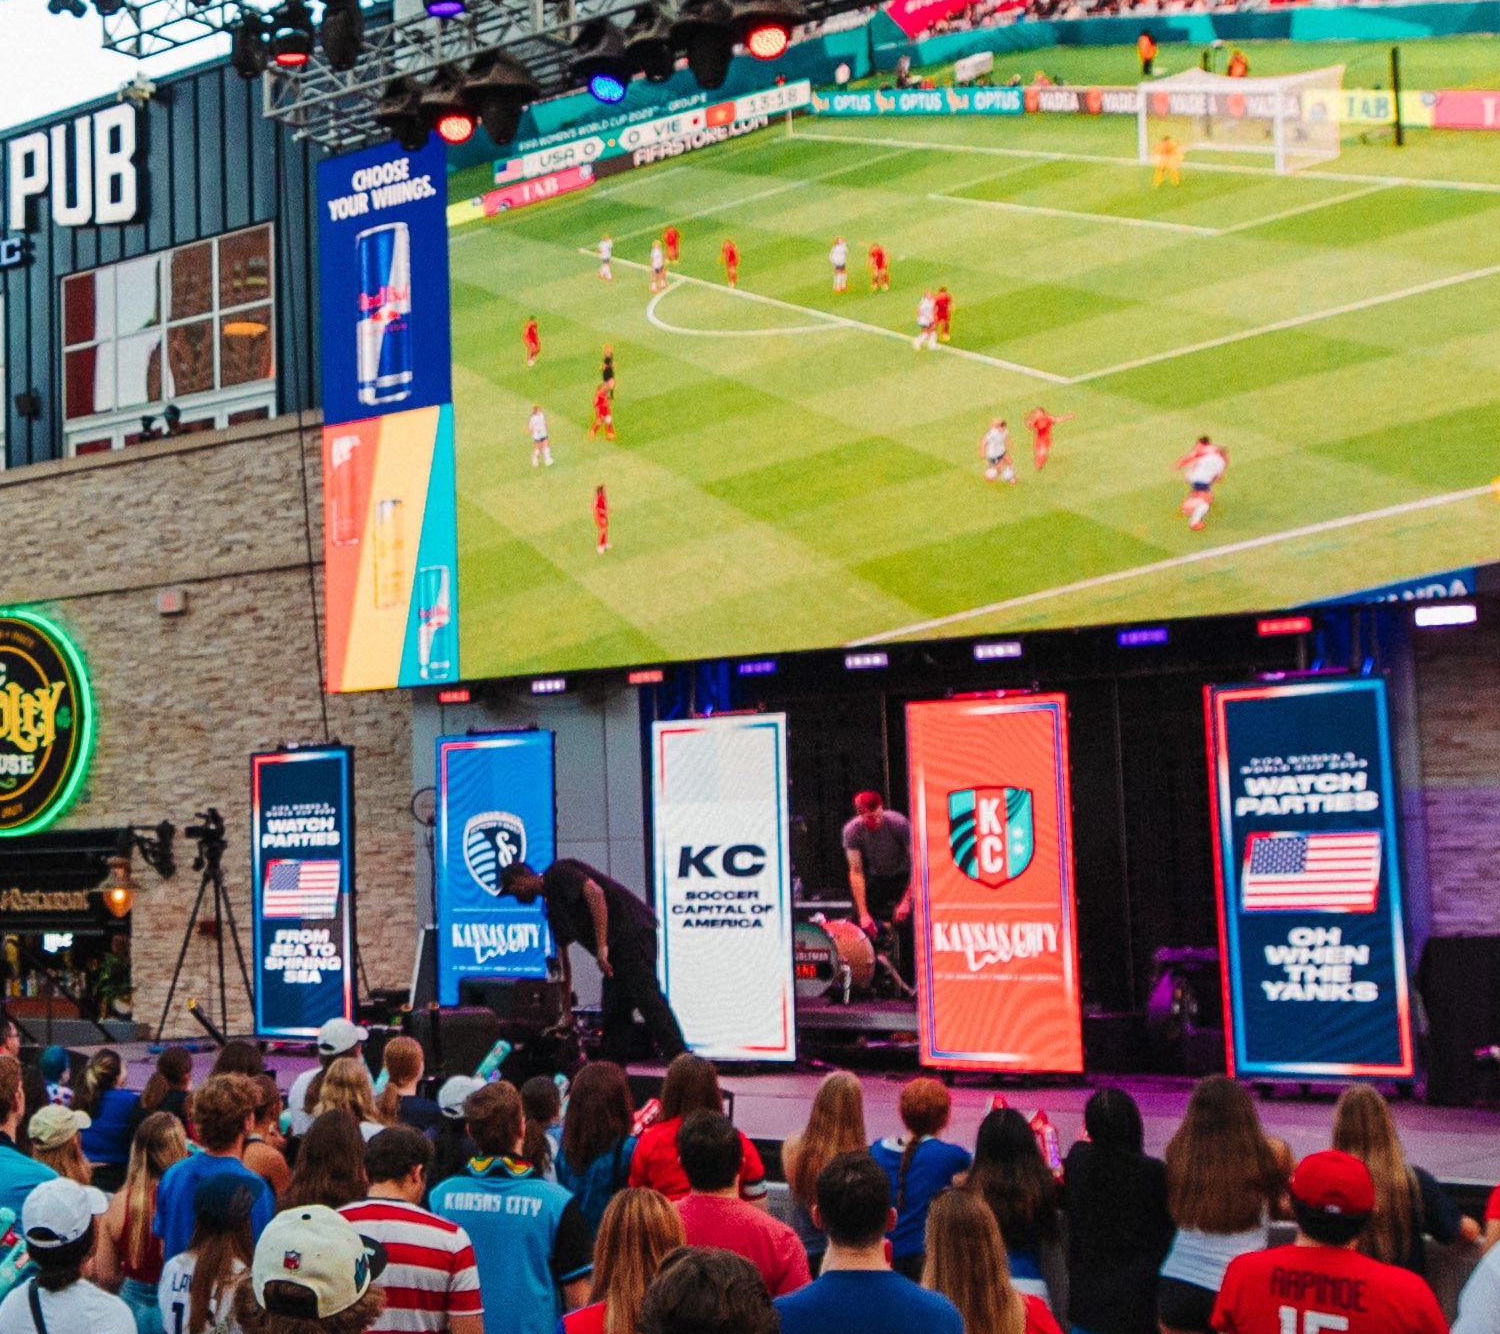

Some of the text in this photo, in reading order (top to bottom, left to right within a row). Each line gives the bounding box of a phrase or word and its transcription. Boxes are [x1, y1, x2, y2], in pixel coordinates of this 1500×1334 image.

[833, 94, 871, 111] OPTUS
[899, 92, 942, 111] OPTUS
[974, 90, 1020, 110] OPTUS
[1102, 91, 1146, 113] YADE
[652, 118, 684, 139] VIE
[8, 103, 137, 230] PUB
[540, 148, 576, 169] USA
[352, 158, 409, 192] CHOOSE
[522, 177, 559, 203] TAB
[328, 192, 369, 222] YOUR
[1244, 772, 1368, 796] WATCH
[1235, 790, 1380, 817] PARTIES
[267, 816, 335, 834] WATCH
[262, 830, 341, 849] PARTIES
[677, 844, 767, 879] KC
[686, 890, 759, 902] SOCCER
[672, 904, 774, 916] CAPITAL OF
[682, 918, 763, 929] AMERICA
[275, 928, 330, 944] FROM
[452, 923, 541, 948] KANSAS CITY
[934, 921, 1059, 953] KANSAS CITY
[1288, 927, 1342, 947] OH
[269, 942, 337, 957] SEA TO
[1264, 945, 1370, 965] WHEN
[264, 955, 342, 971] SHINING
[283, 969, 322, 984] SEA
[1284, 964, 1352, 983] THE
[1261, 981, 1379, 1002] YANKS
[444, 1192, 543, 1218] KANSAS CITY
[1270, 1267, 1368, 1314] RAPINOE
